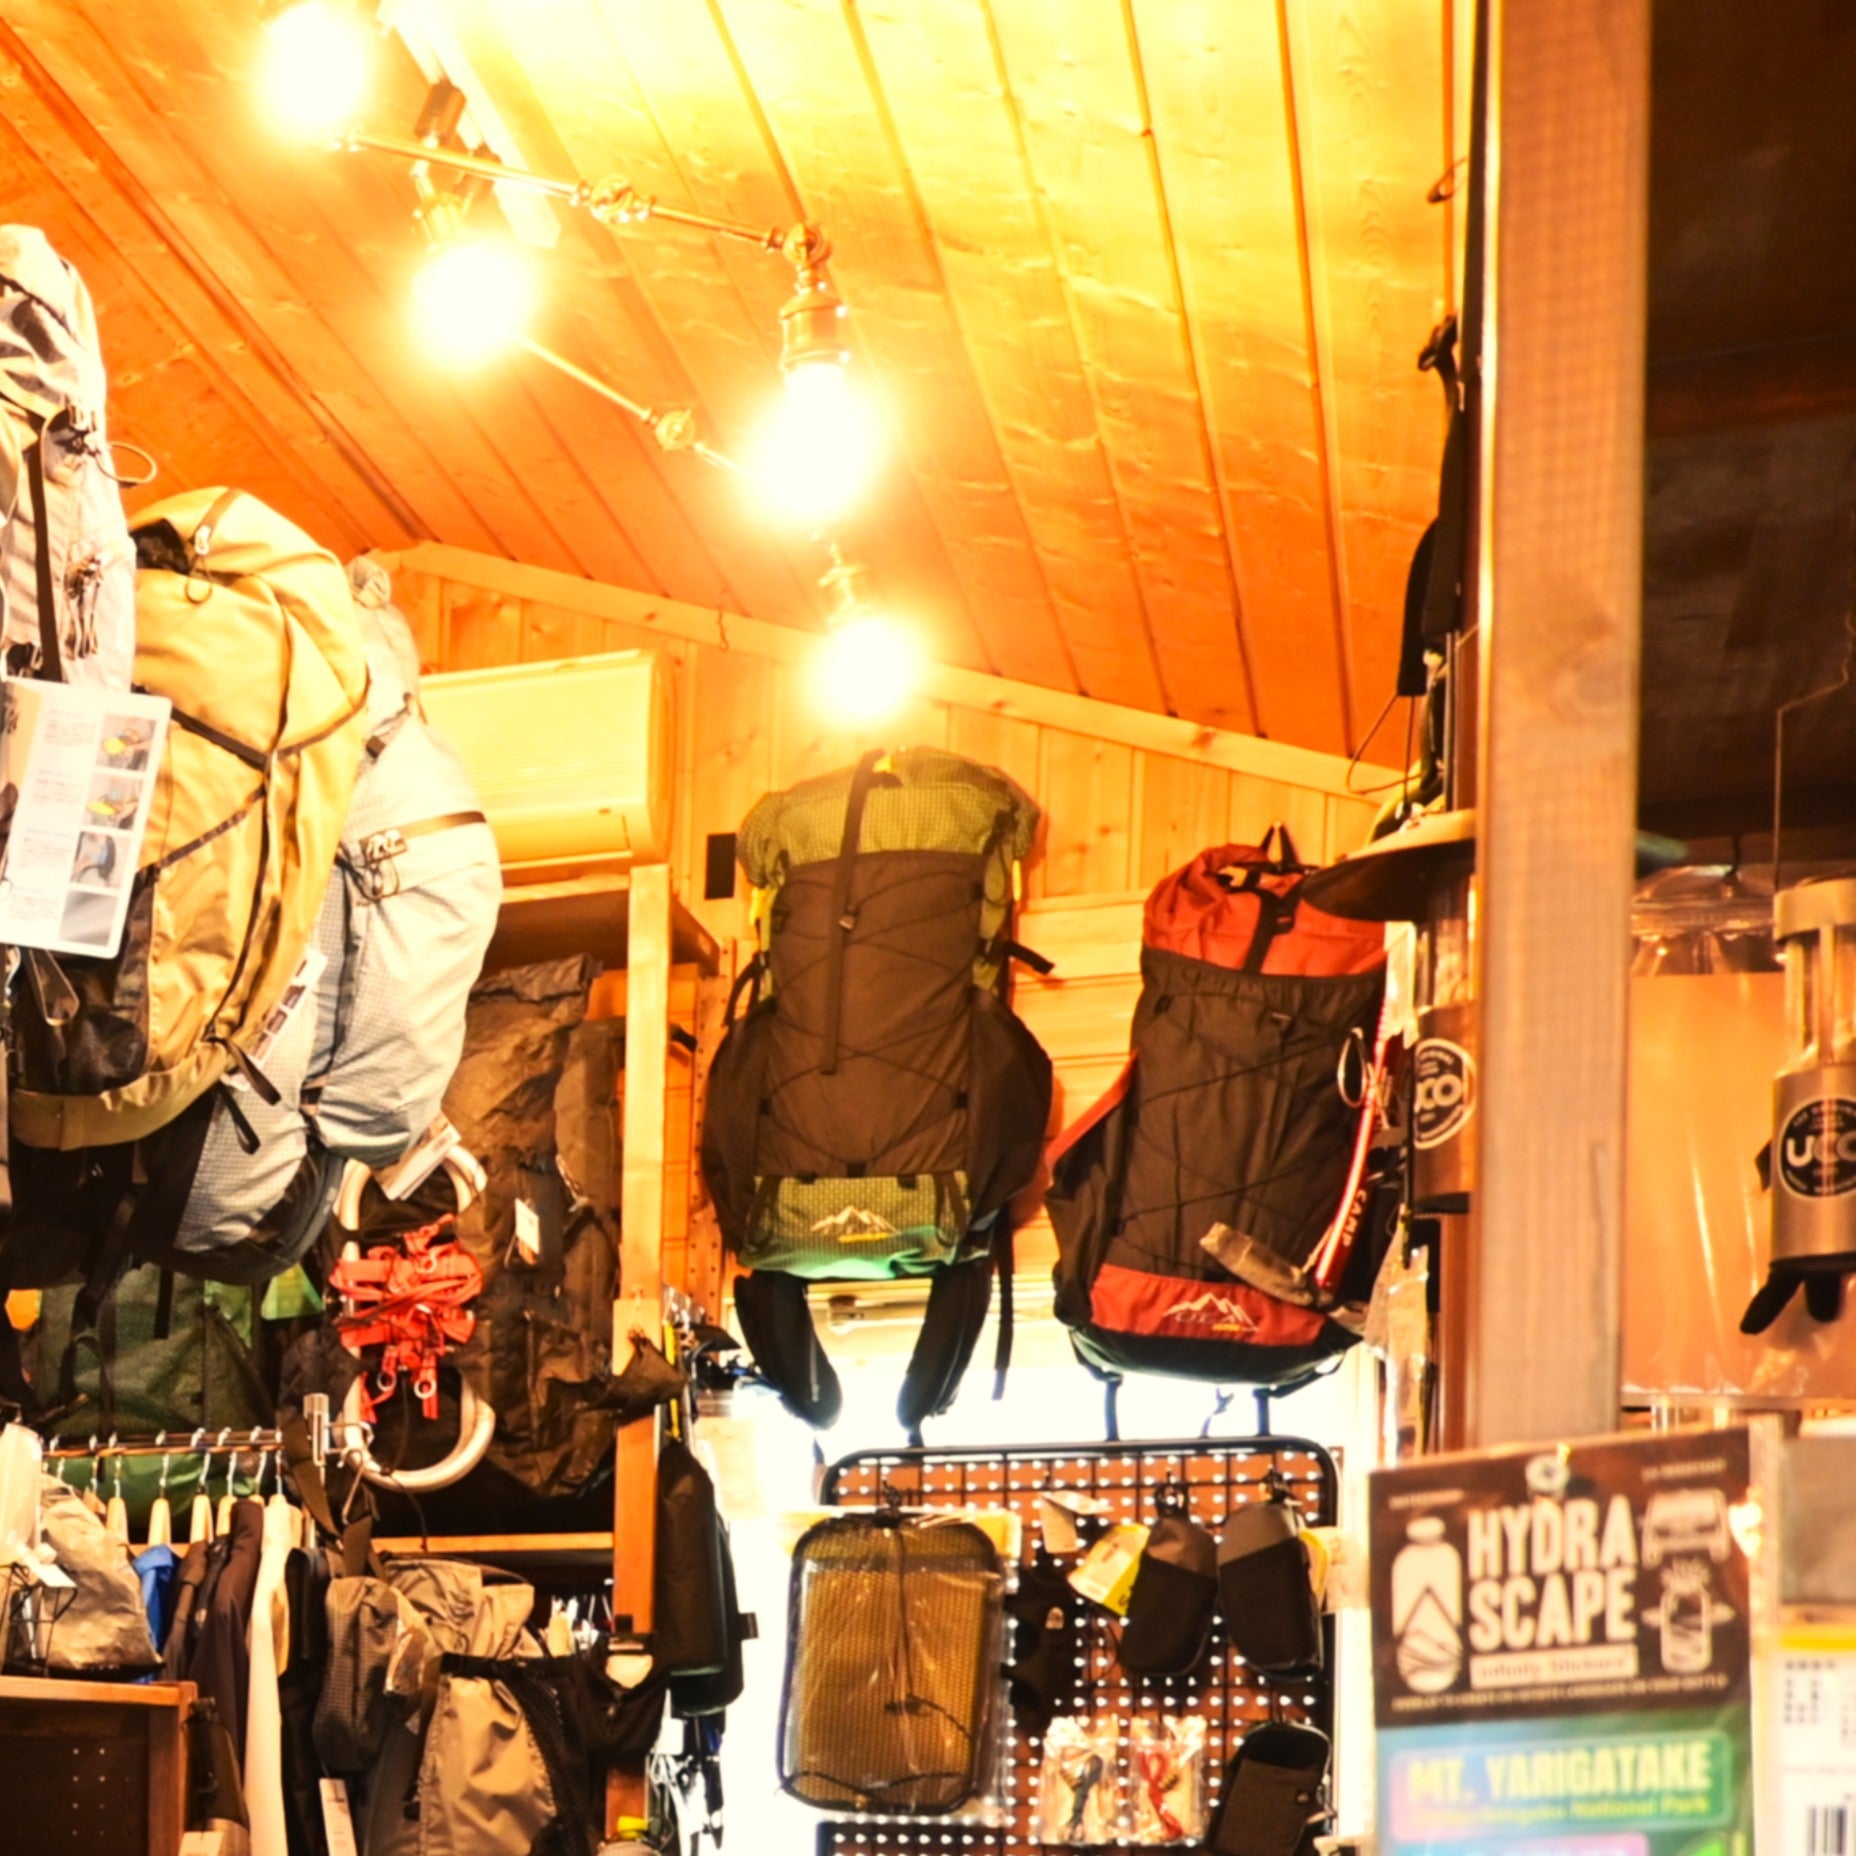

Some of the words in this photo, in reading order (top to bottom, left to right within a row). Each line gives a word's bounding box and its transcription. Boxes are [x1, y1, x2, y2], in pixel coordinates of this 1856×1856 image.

[1466, 1494, 1638, 1579] HYDRA
[1467, 1565, 1638, 1653] SCAPE
[1483, 1740, 1713, 1799] YARIGATAKE
